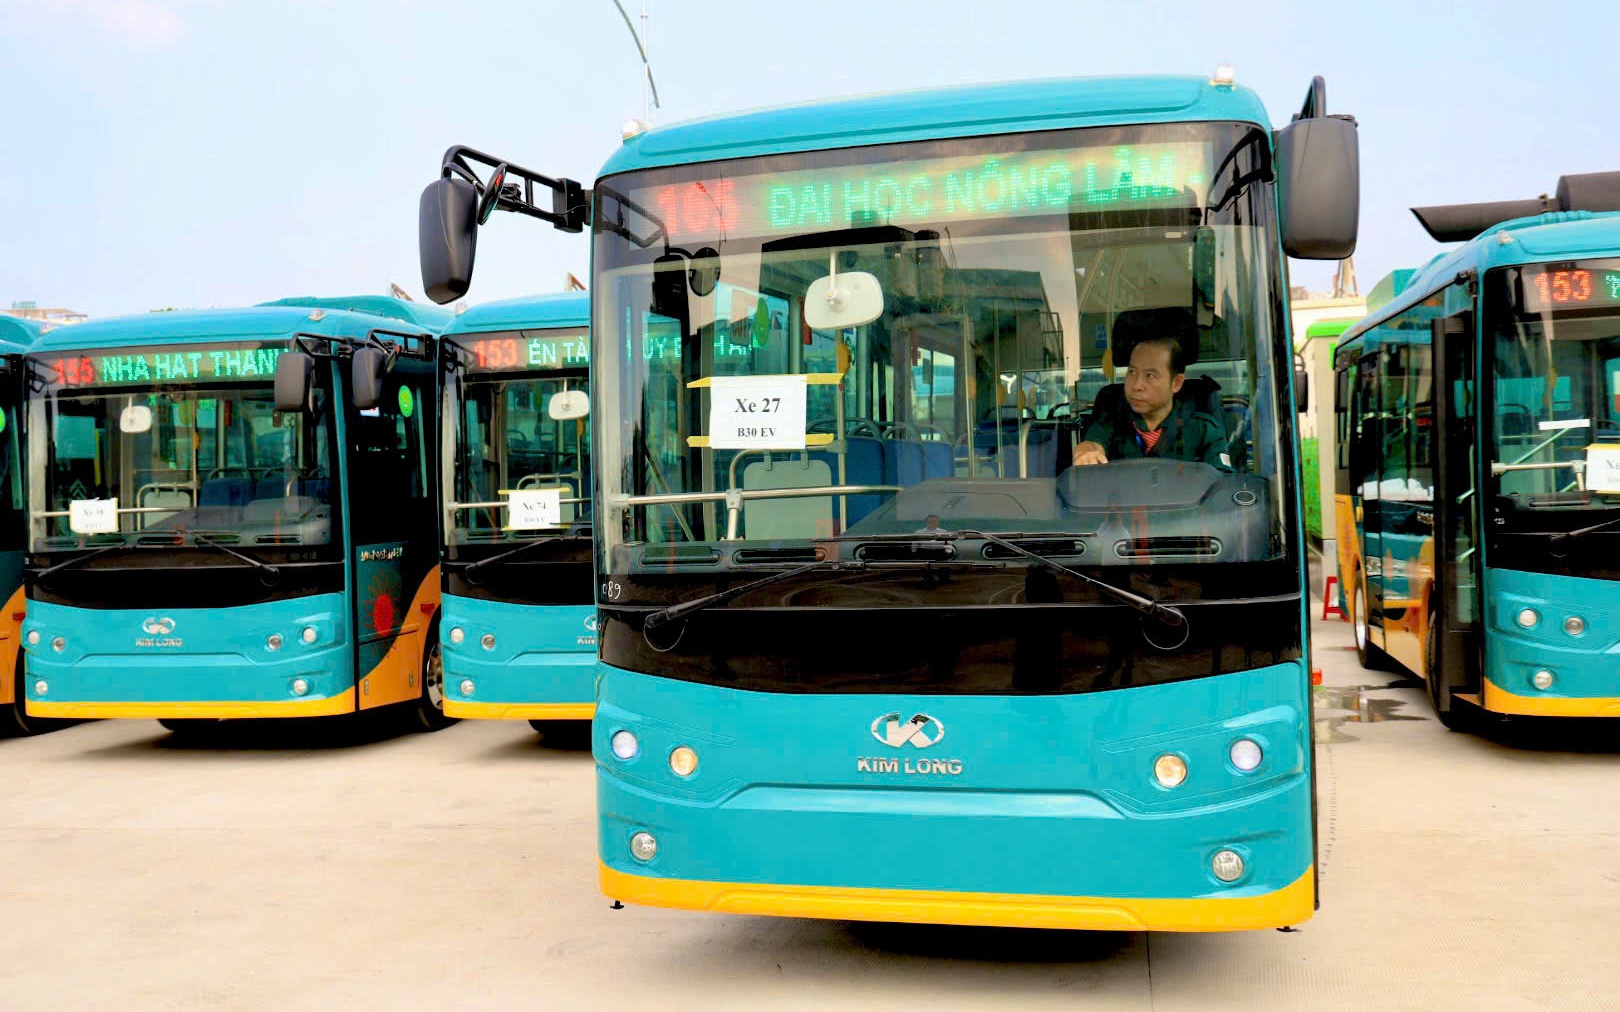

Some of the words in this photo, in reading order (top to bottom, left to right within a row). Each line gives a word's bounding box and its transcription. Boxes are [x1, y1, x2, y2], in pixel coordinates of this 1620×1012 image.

[945, 159, 1072, 213] NÔNG
[1086, 148, 1175, 204] LÂM
[1534, 270, 1592, 303] 153
[474, 339, 518, 367] 153
[53, 356, 95, 384] 155
[734, 398, 757, 413] Xe
[761, 397, 781, 413] 27
[737, 427, 757, 438] B30
[760, 427, 777, 437] EV
[156, 638, 183, 648] LONG
[857, 757, 899, 773] KIM
[904, 758, 963, 775] LONG
